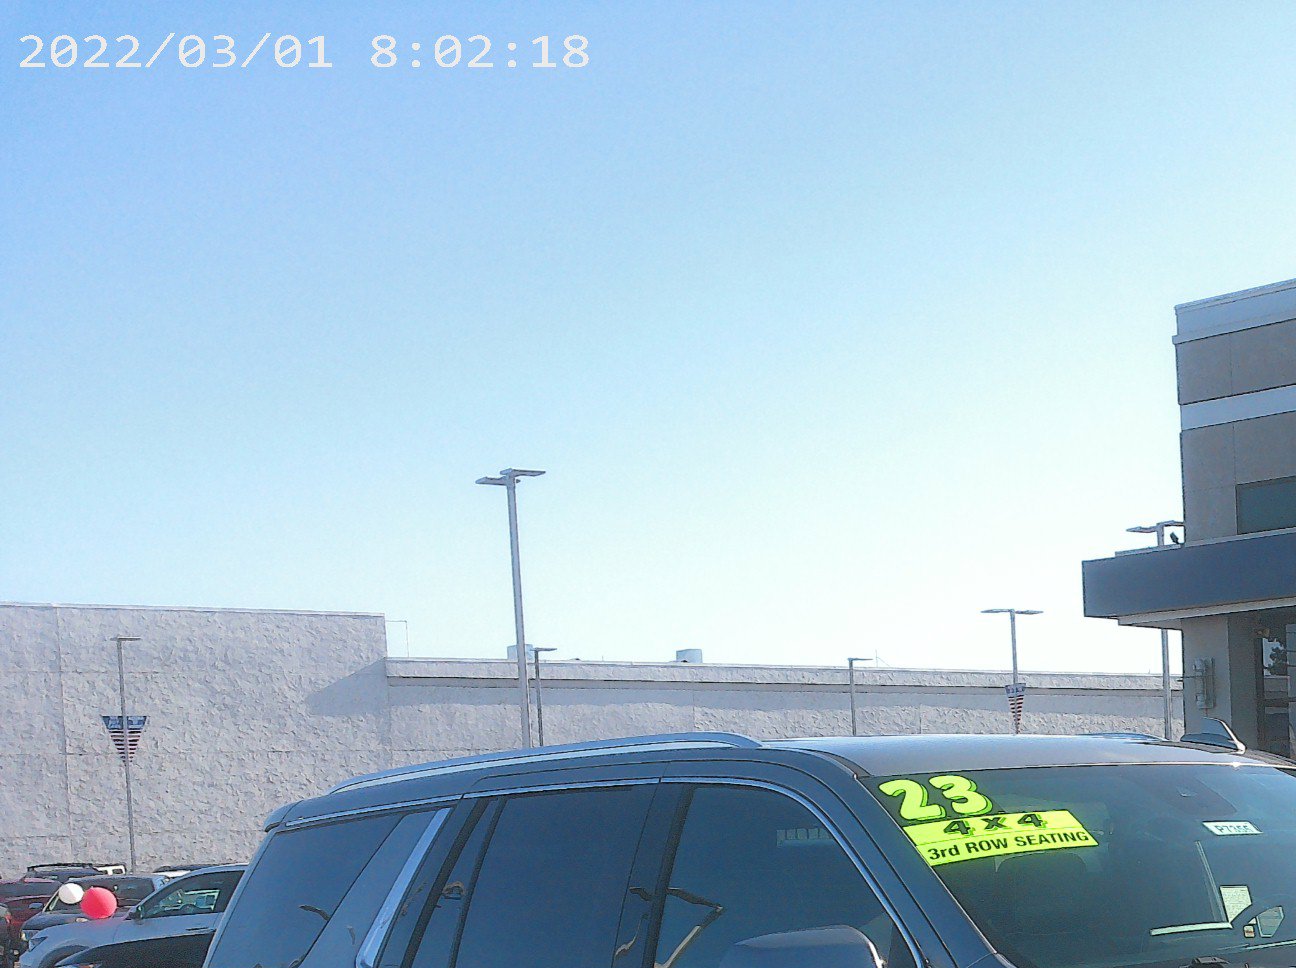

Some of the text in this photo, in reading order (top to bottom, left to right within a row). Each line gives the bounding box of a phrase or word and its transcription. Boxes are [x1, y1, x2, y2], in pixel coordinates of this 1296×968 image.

[879, 775, 993, 821] 23
[927, 831, 1090, 861] 3rd ROW SEATING
